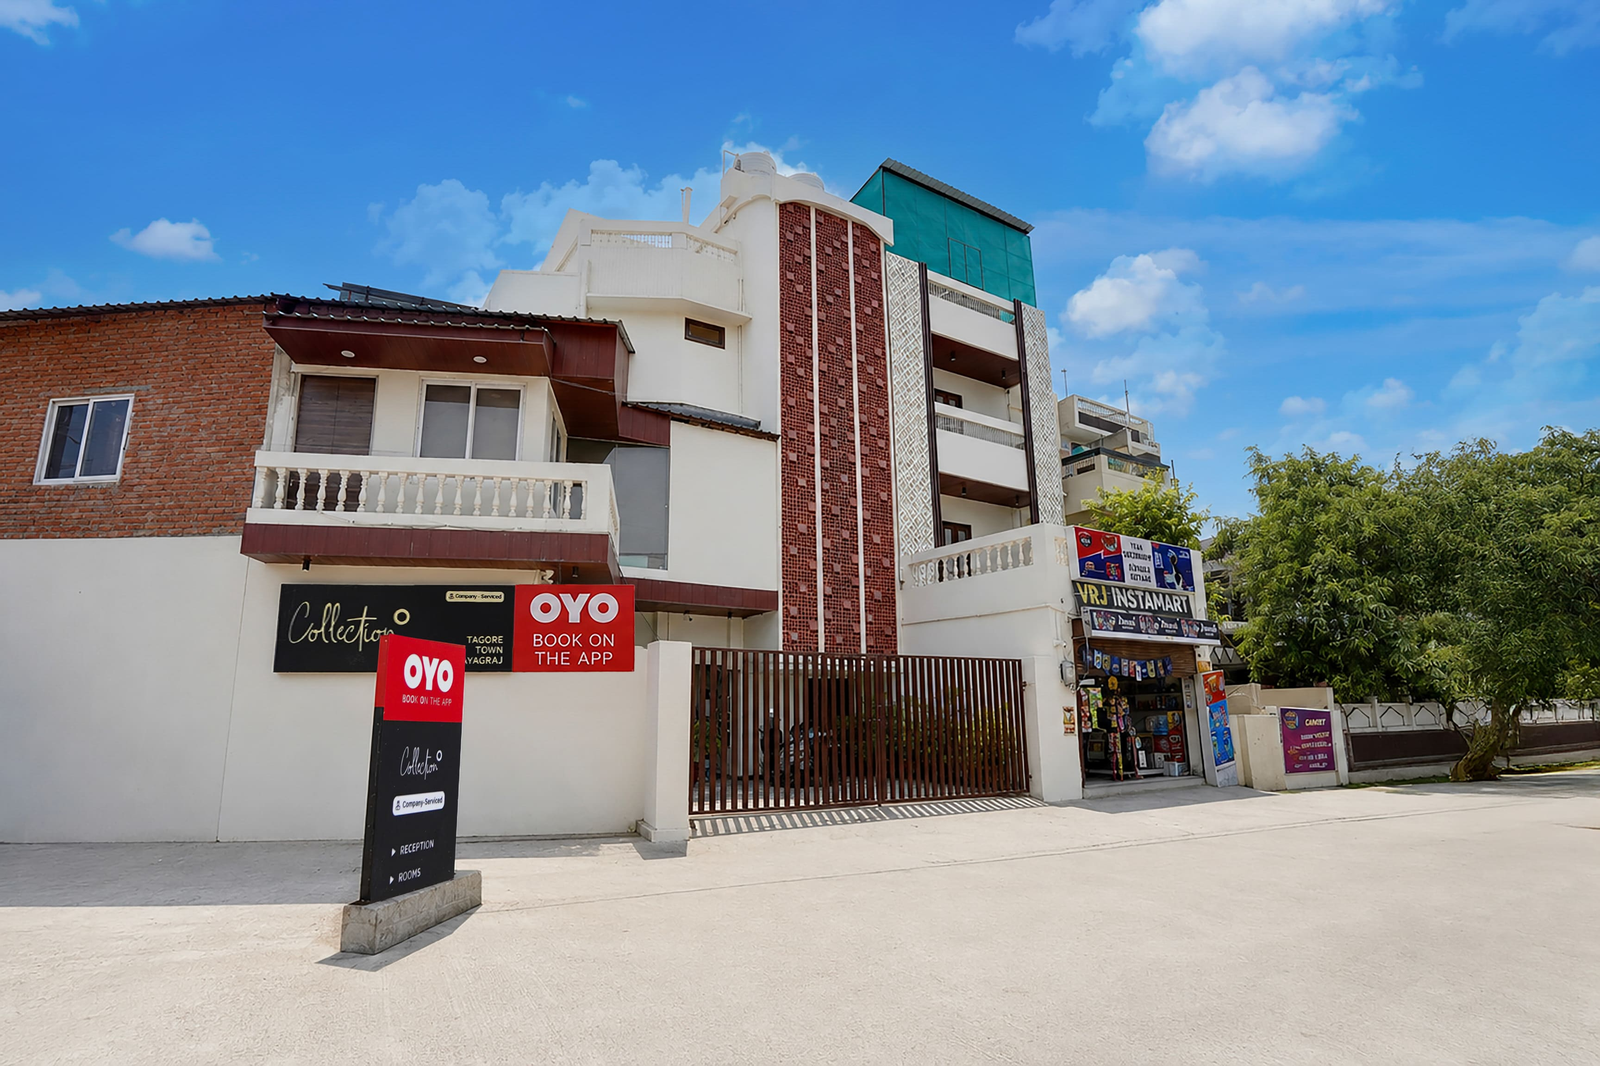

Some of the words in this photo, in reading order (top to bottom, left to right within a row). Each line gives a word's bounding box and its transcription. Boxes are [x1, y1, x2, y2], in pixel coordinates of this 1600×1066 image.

[1076, 582, 1108, 606] VRJ
[1111, 587, 1189, 614] INSTAMART
[530, 592, 619, 624] OYO
[466, 636, 504, 644] TAGORE
[532, 634, 582, 648] BOOK
[589, 633, 615, 647] ON
[475, 646, 504, 654] TOWN
[535, 651, 571, 665] THE
[577, 650, 613, 665] APP
[404, 654, 454, 692] OYO
[402, 694, 418, 704] BOOK
[420, 696, 428, 704] ON
[430, 696, 440, 706] THE
[442, 698, 452, 706] APP
[400, 746, 438, 780] Collection
[400, 839, 434, 856] RECEPTION
[398, 867, 422, 882] ROOMS
